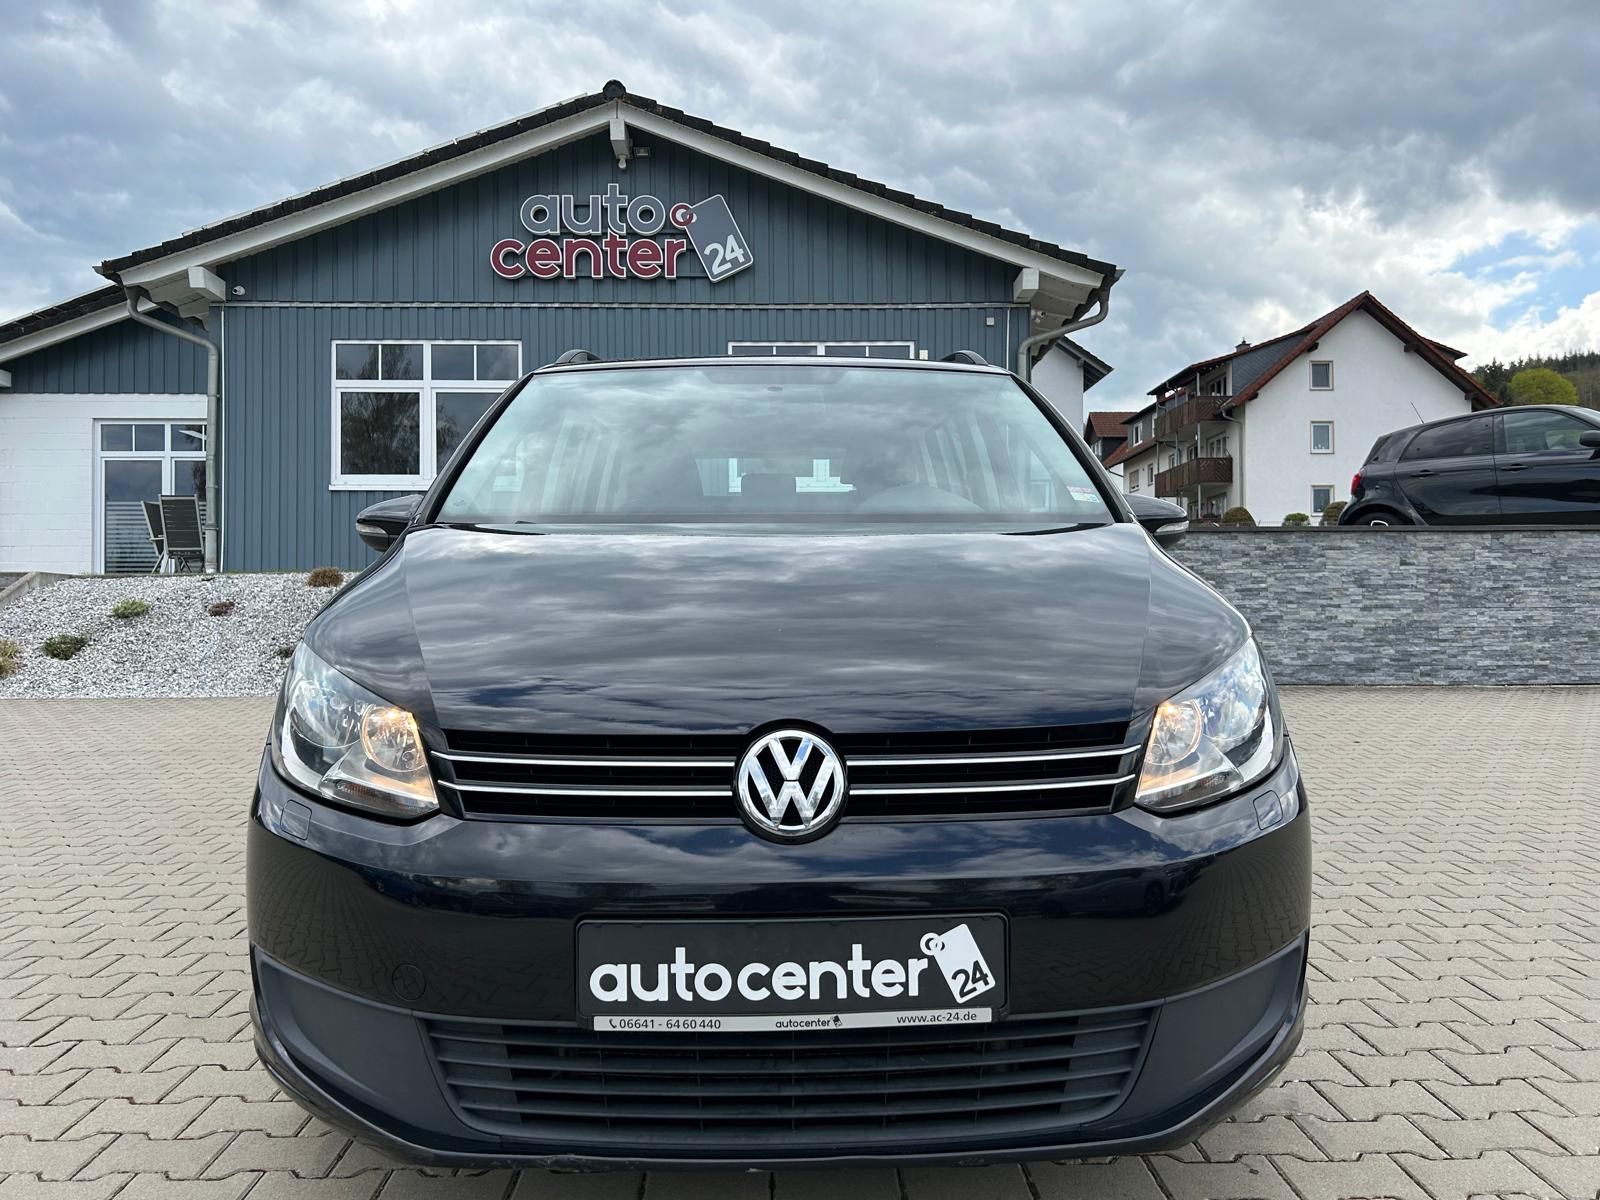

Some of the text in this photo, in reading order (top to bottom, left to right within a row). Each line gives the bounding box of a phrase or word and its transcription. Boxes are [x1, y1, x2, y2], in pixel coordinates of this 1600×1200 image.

[520, 183, 666, 234] auto
[490, 231, 687, 280] center
[703, 234, 745, 276] 24
[951, 959, 990, 999] 24
[775, 1018, 831, 1028] autocenter
[896, 1011, 977, 1024] www.ac-24.de
